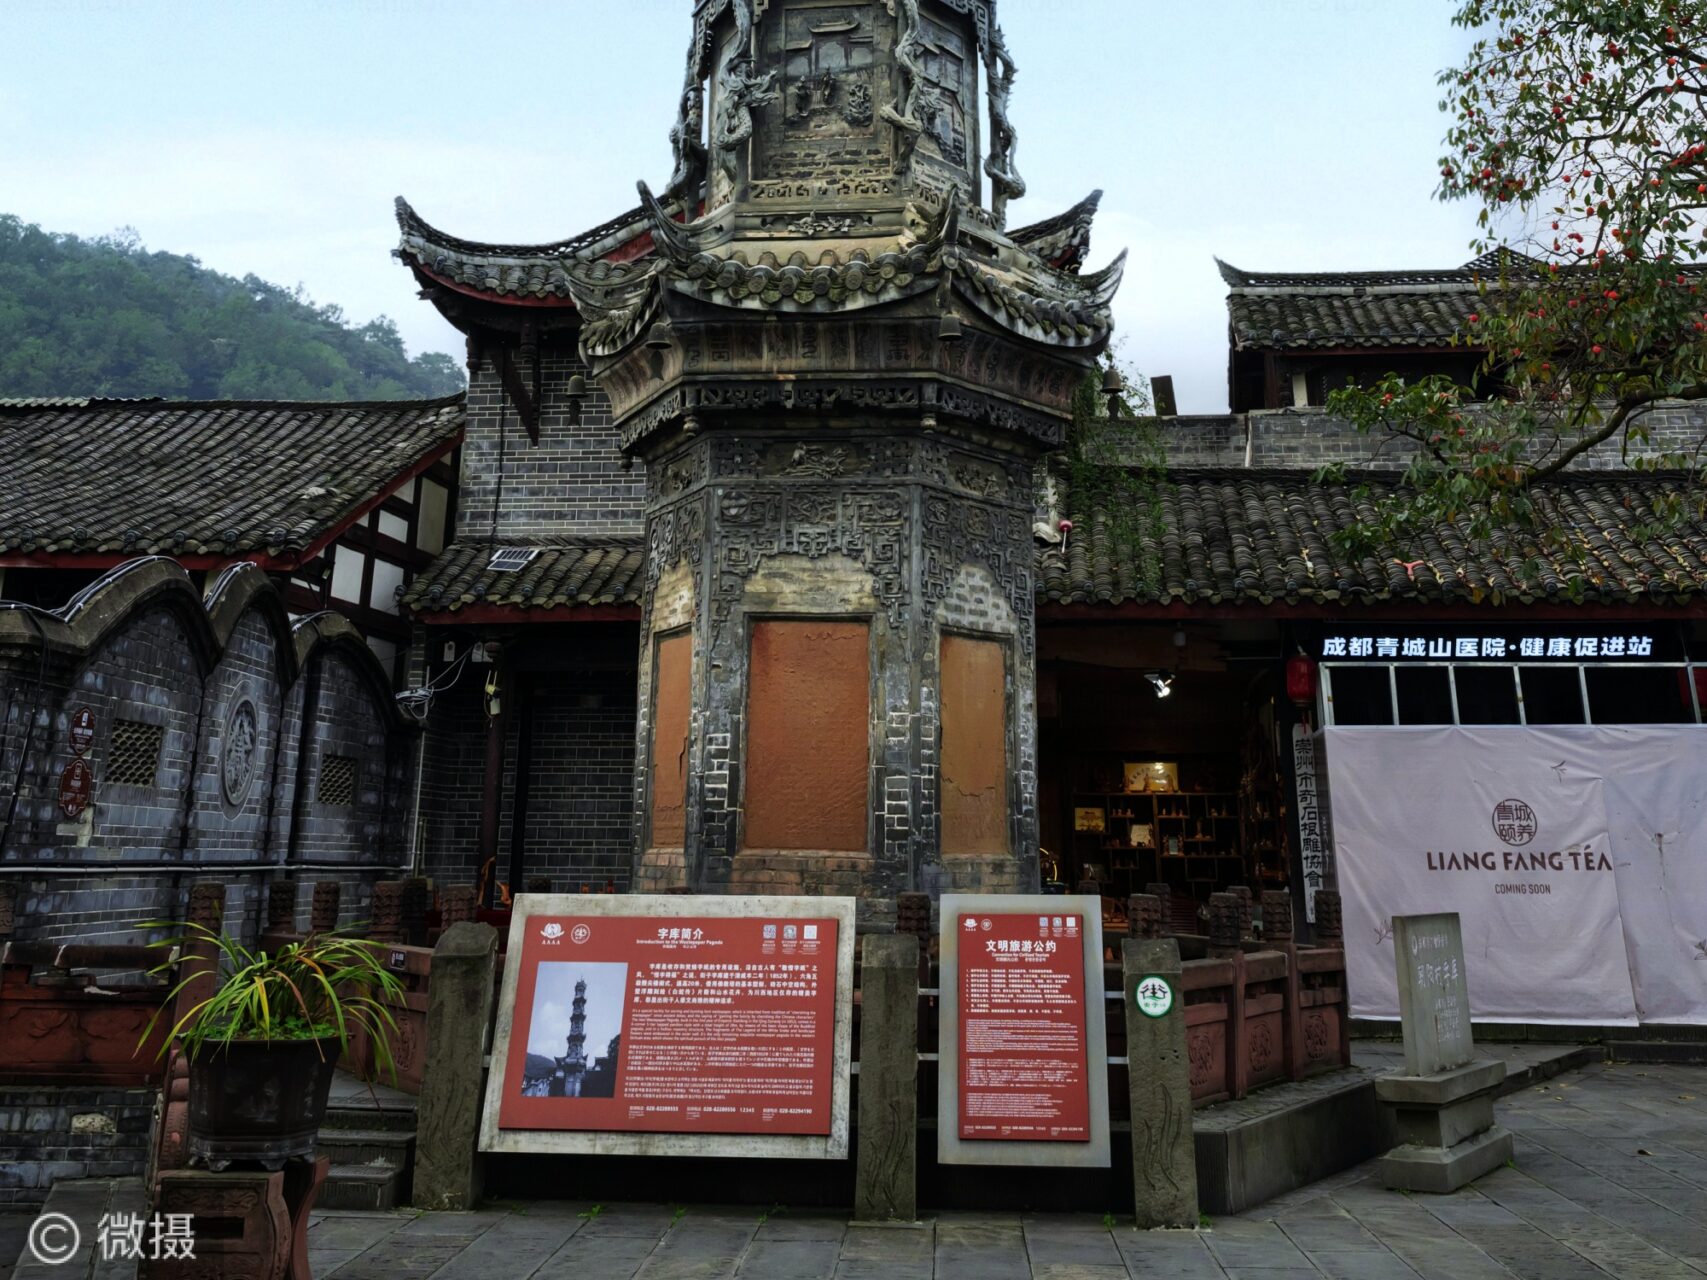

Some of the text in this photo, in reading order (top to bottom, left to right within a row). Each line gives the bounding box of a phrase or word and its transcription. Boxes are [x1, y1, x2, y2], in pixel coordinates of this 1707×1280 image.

[1323, 636, 1653, 657] 成都青城山医院·健康促进站
[1427, 852, 1496, 871] LIANG
[1503, 852, 1564, 871] FANG
[1495, 884, 1551, 895] COMING SOON
[658, 927, 704, 940] 字库简介
[986, 939, 1057, 953] 文明旅游公约
